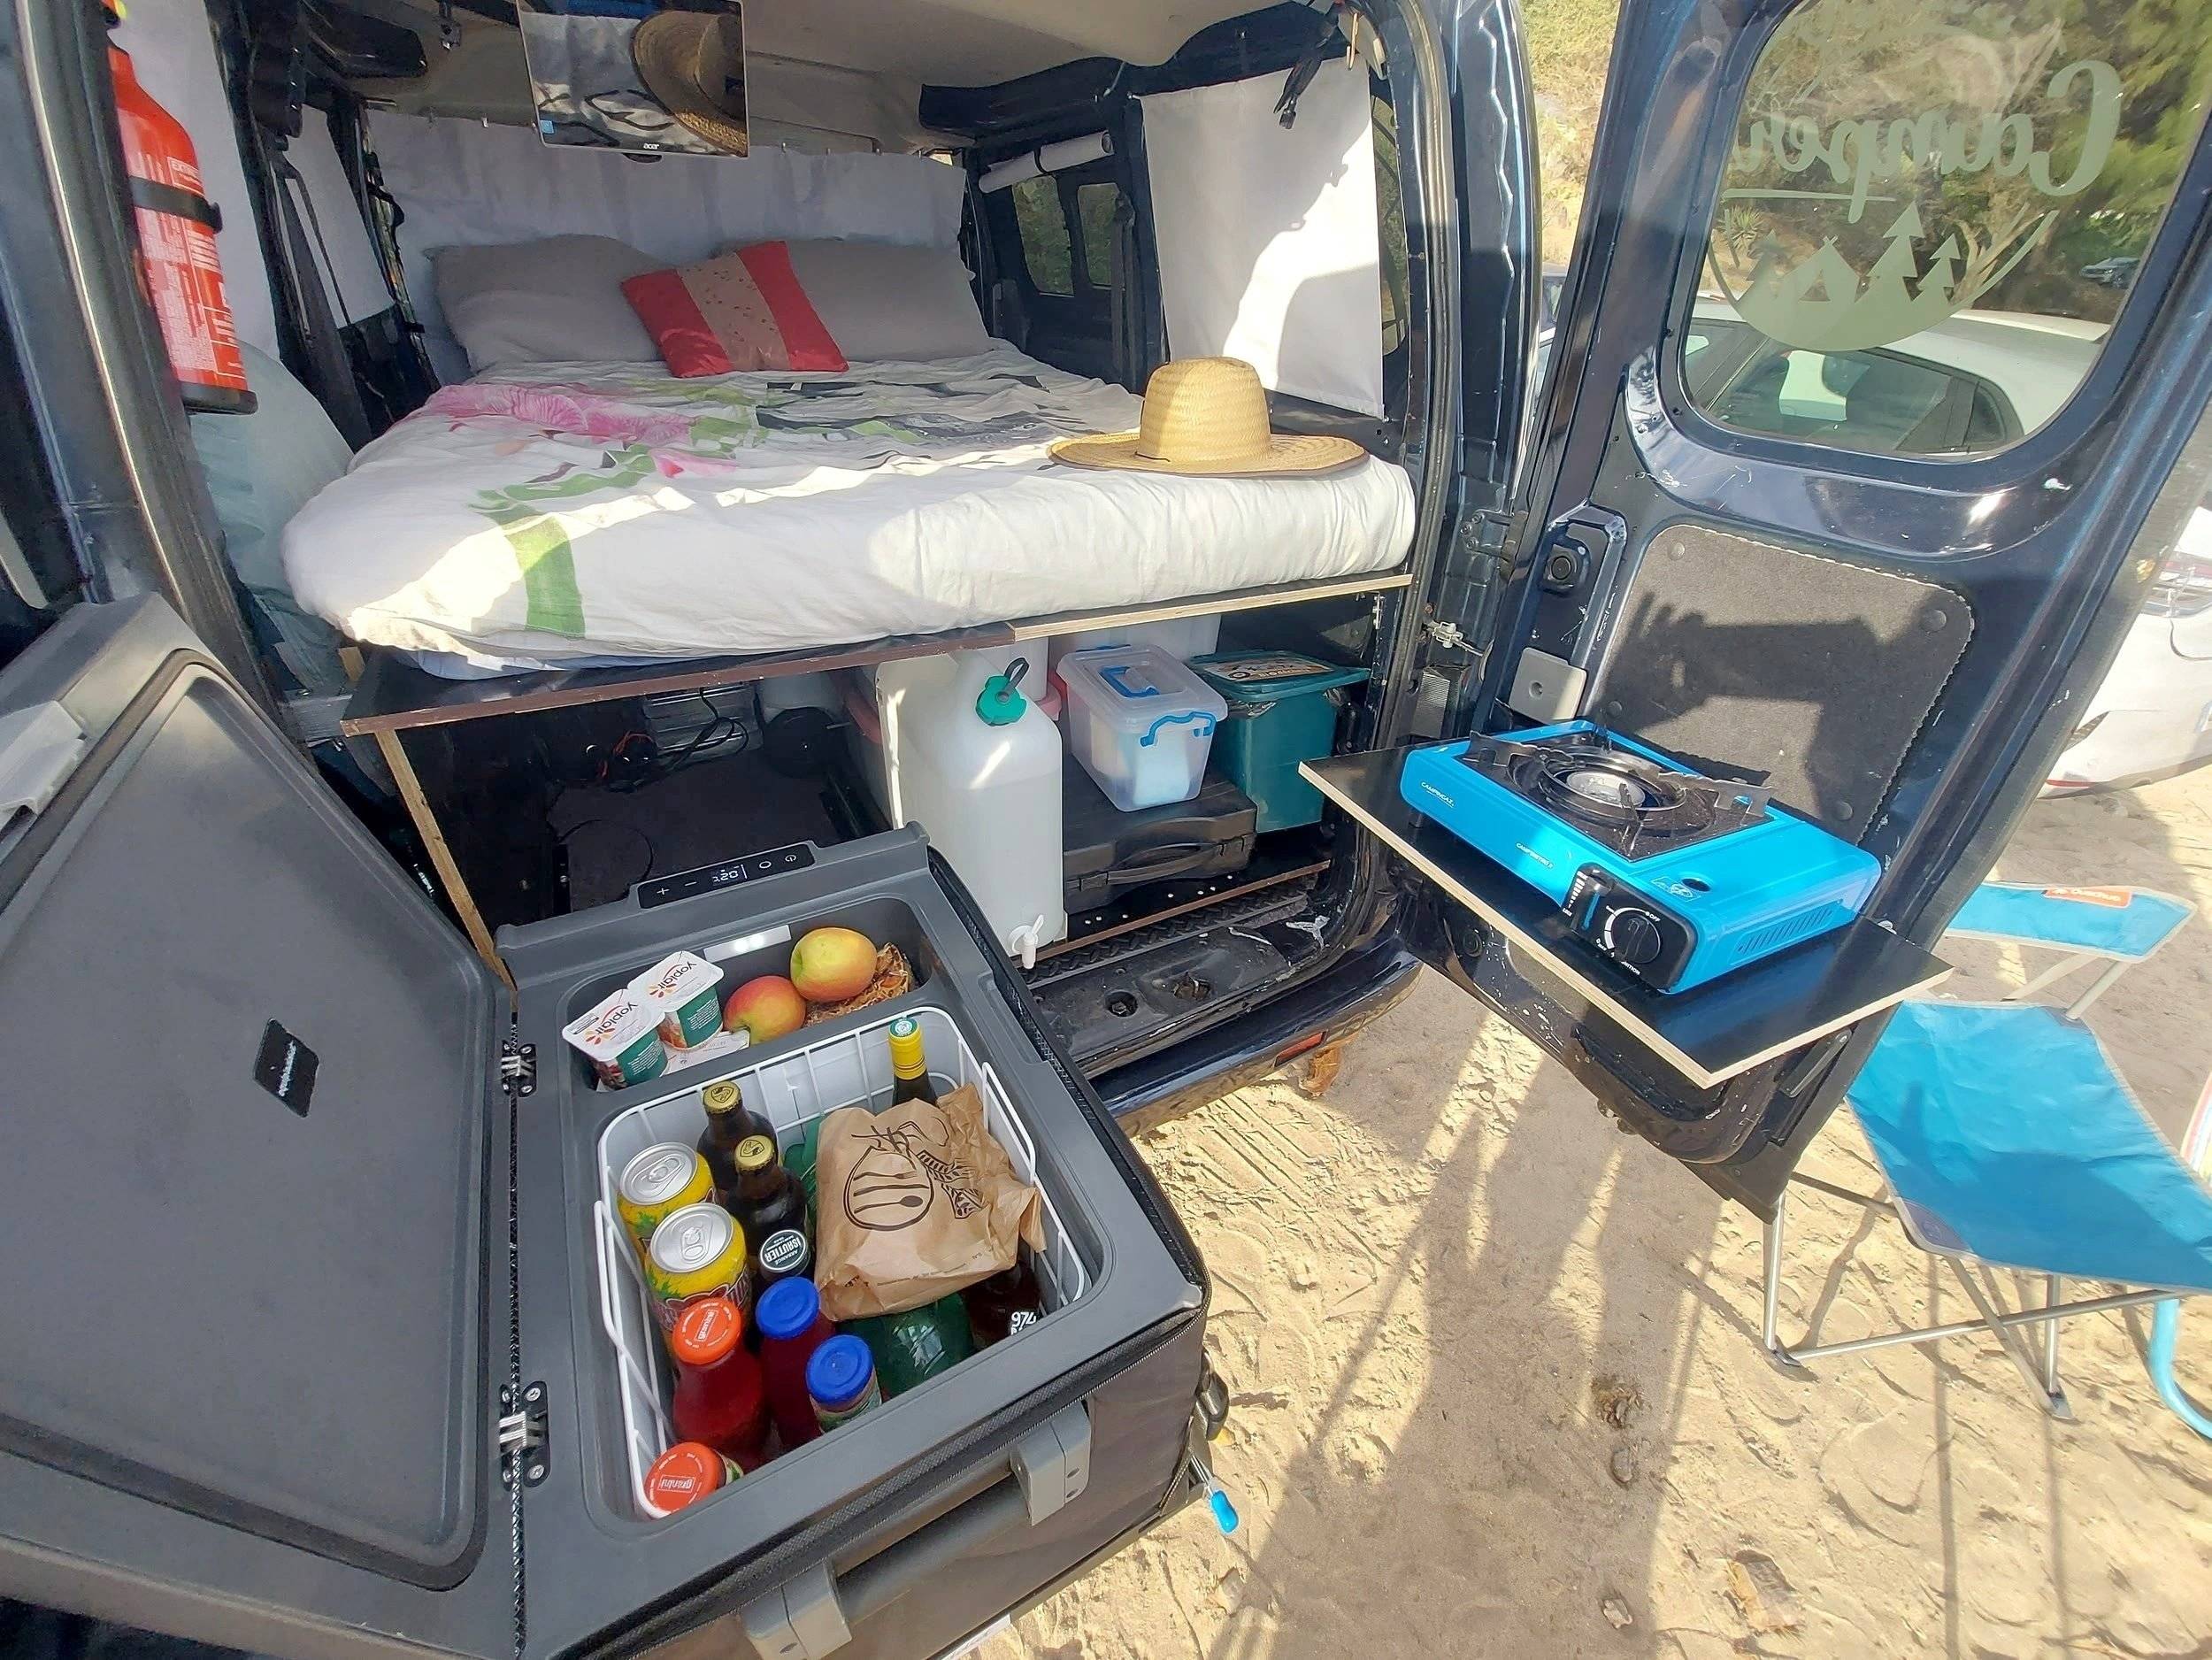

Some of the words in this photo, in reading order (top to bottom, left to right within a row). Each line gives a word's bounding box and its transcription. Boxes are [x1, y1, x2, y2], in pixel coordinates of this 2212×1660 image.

[1649, 913, 1661, 923] OFF
[764, 1236, 802, 1263] ISAUTIER
[1010, 1311, 1037, 1332] 974
